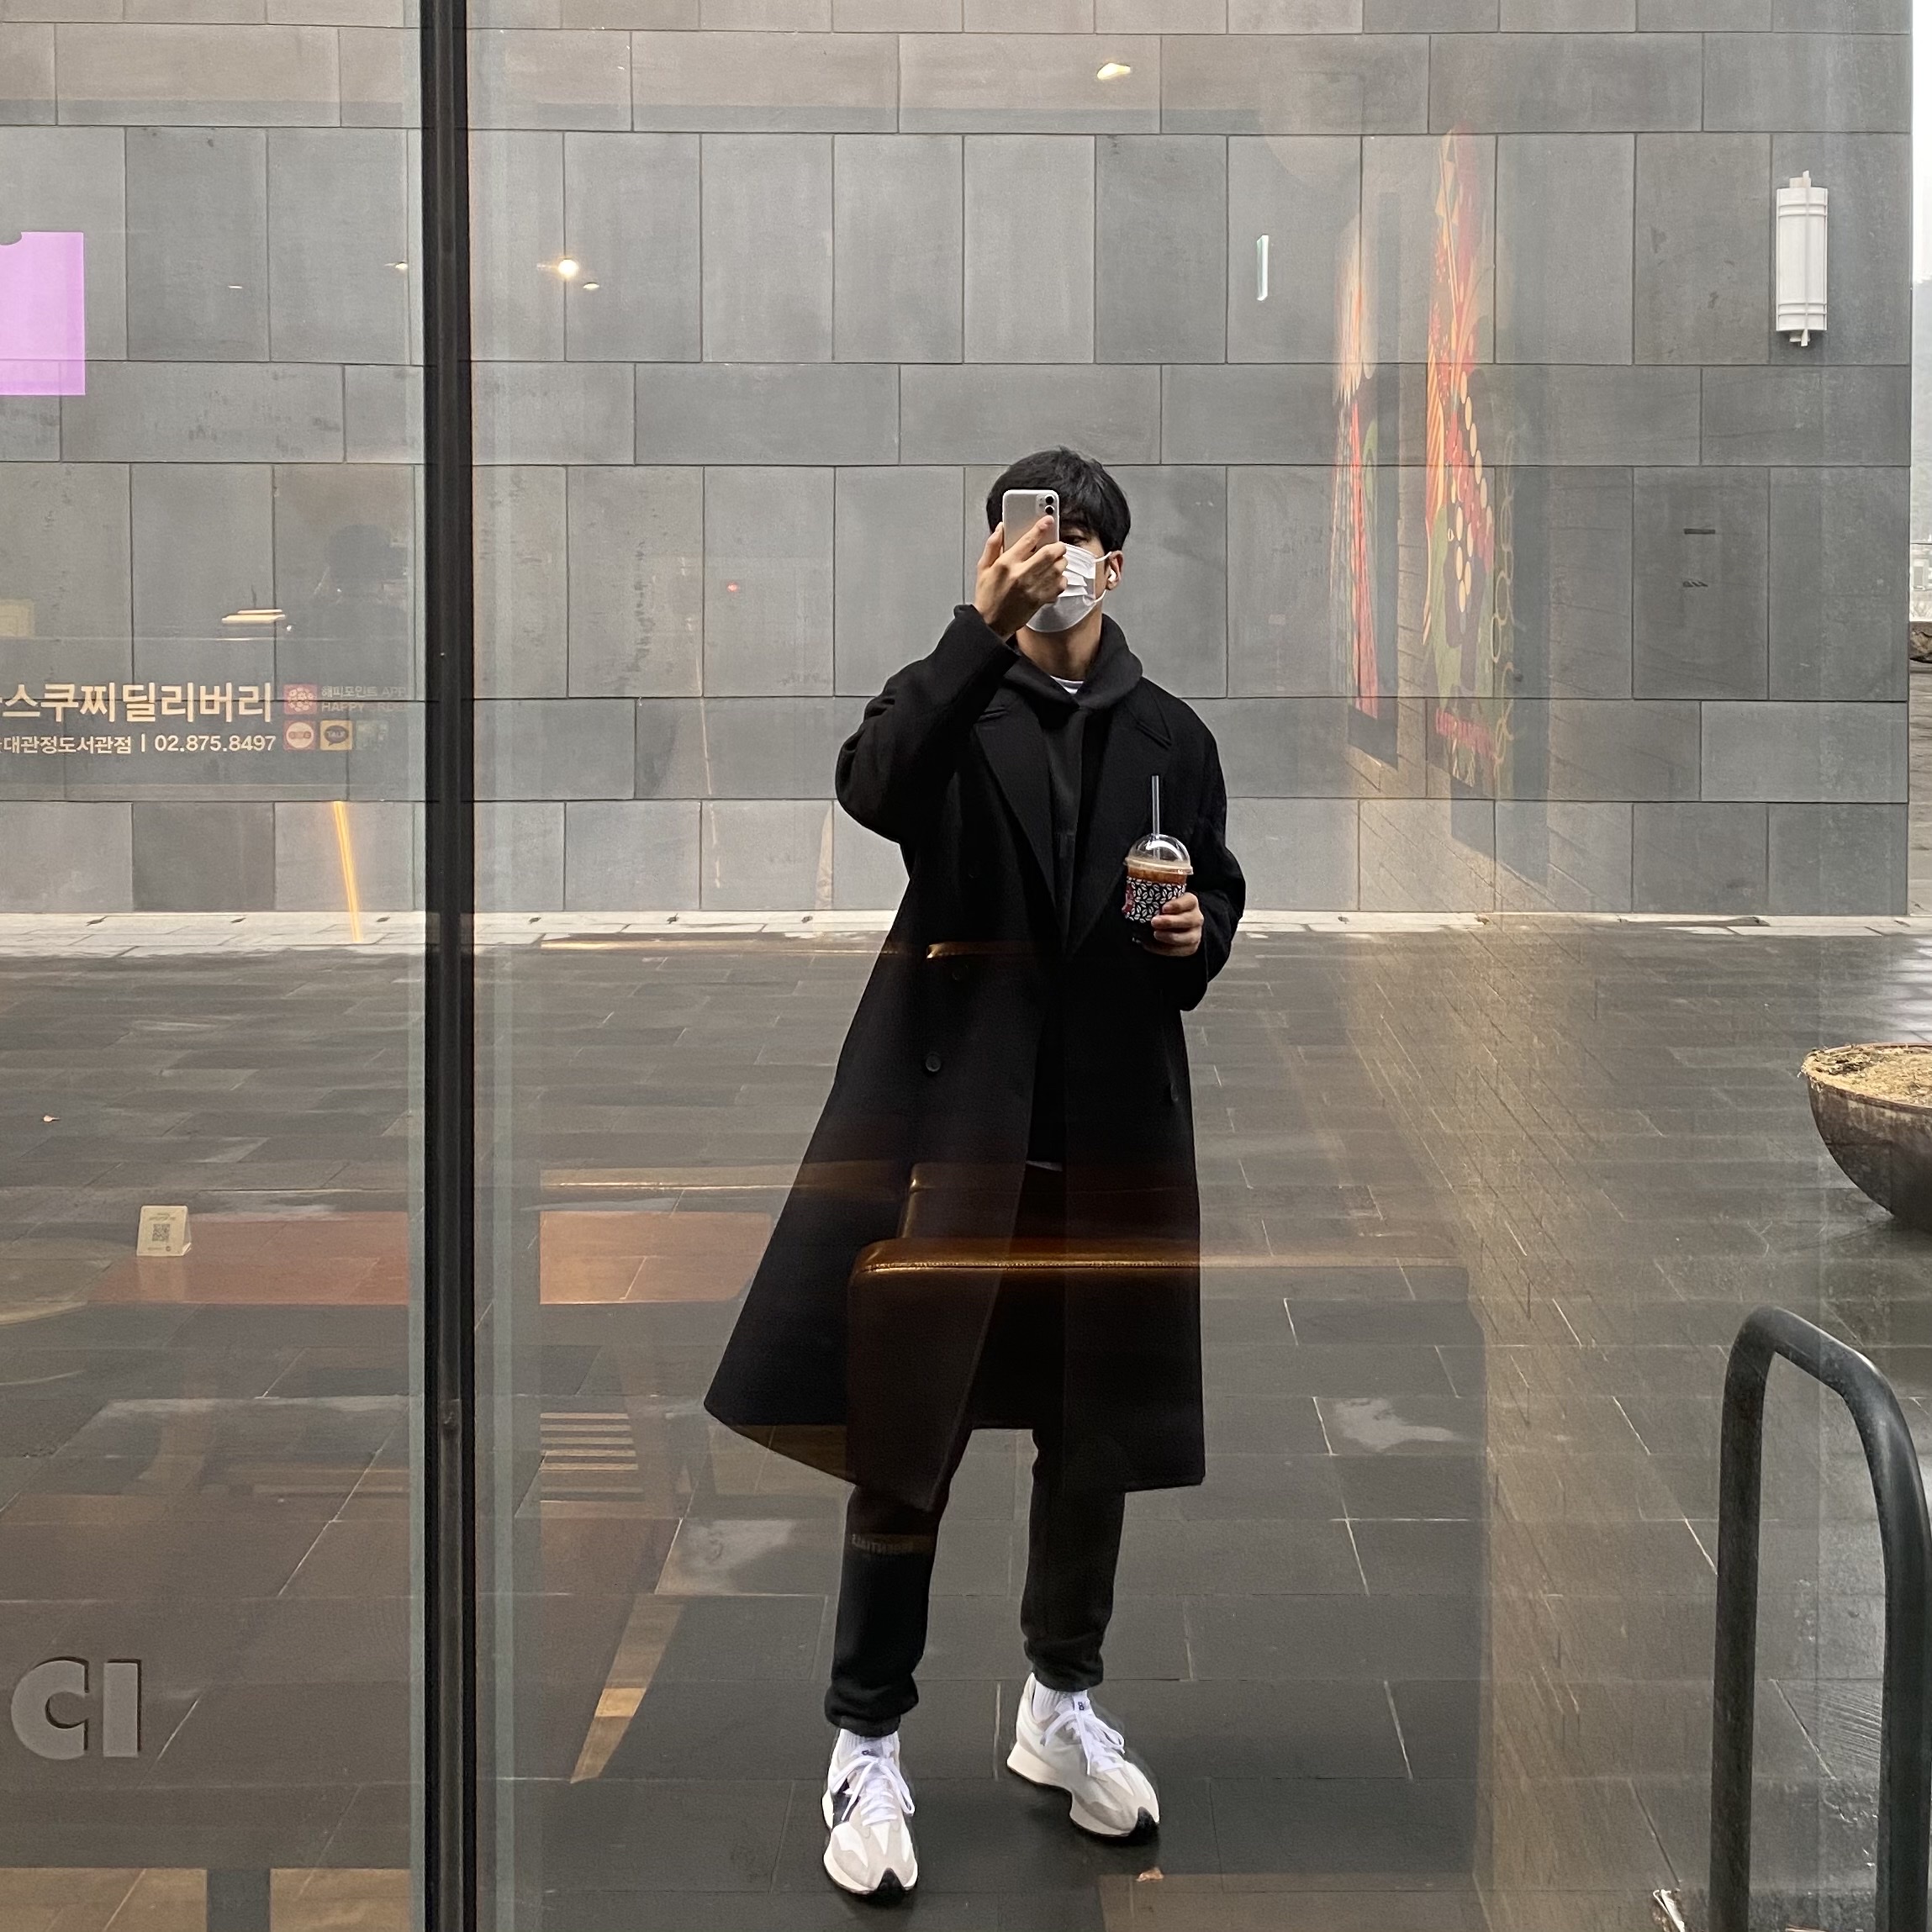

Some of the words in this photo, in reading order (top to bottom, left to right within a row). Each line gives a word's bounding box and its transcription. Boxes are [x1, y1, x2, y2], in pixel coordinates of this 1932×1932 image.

[0, 682, 272, 722] 스쿠찌딜리버리
[321, 685, 377, 698] 해피포인트
[0, 736, 132, 754] 대관정도서관점
[154, 735, 277, 752] 02.875.8497
[10, 1656, 141, 1760] CI
